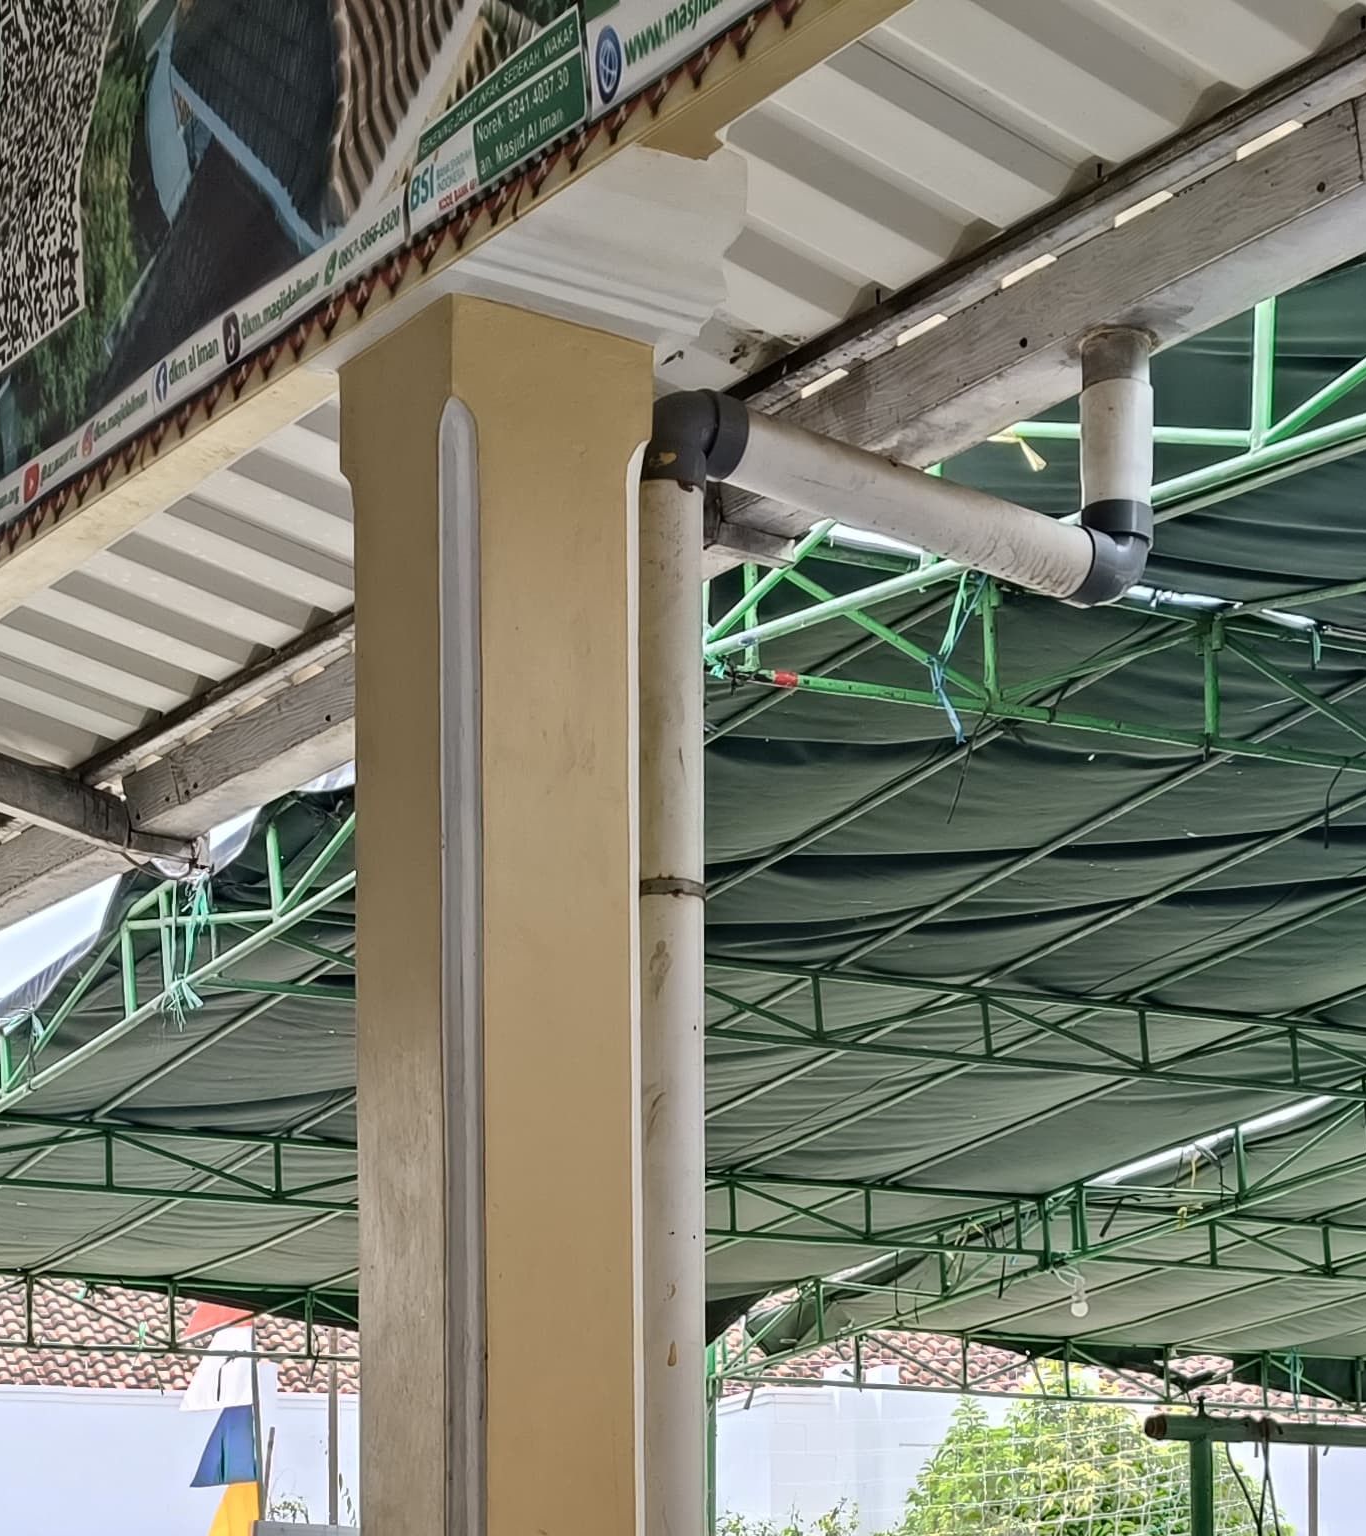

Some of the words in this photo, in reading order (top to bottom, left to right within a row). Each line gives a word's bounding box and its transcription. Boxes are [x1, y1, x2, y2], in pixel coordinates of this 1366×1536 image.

[543, 24, 575, 59] WAKAF
[495, 128, 526, 162] Masjid
[527, 121, 537, 139] Al
[539, 107, 564, 136] Iman
[410, 163, 434, 211] BSI
[169, 353, 188, 386] dkm
[188, 346, 197, 369] al
[197, 337, 220, 366] iman
